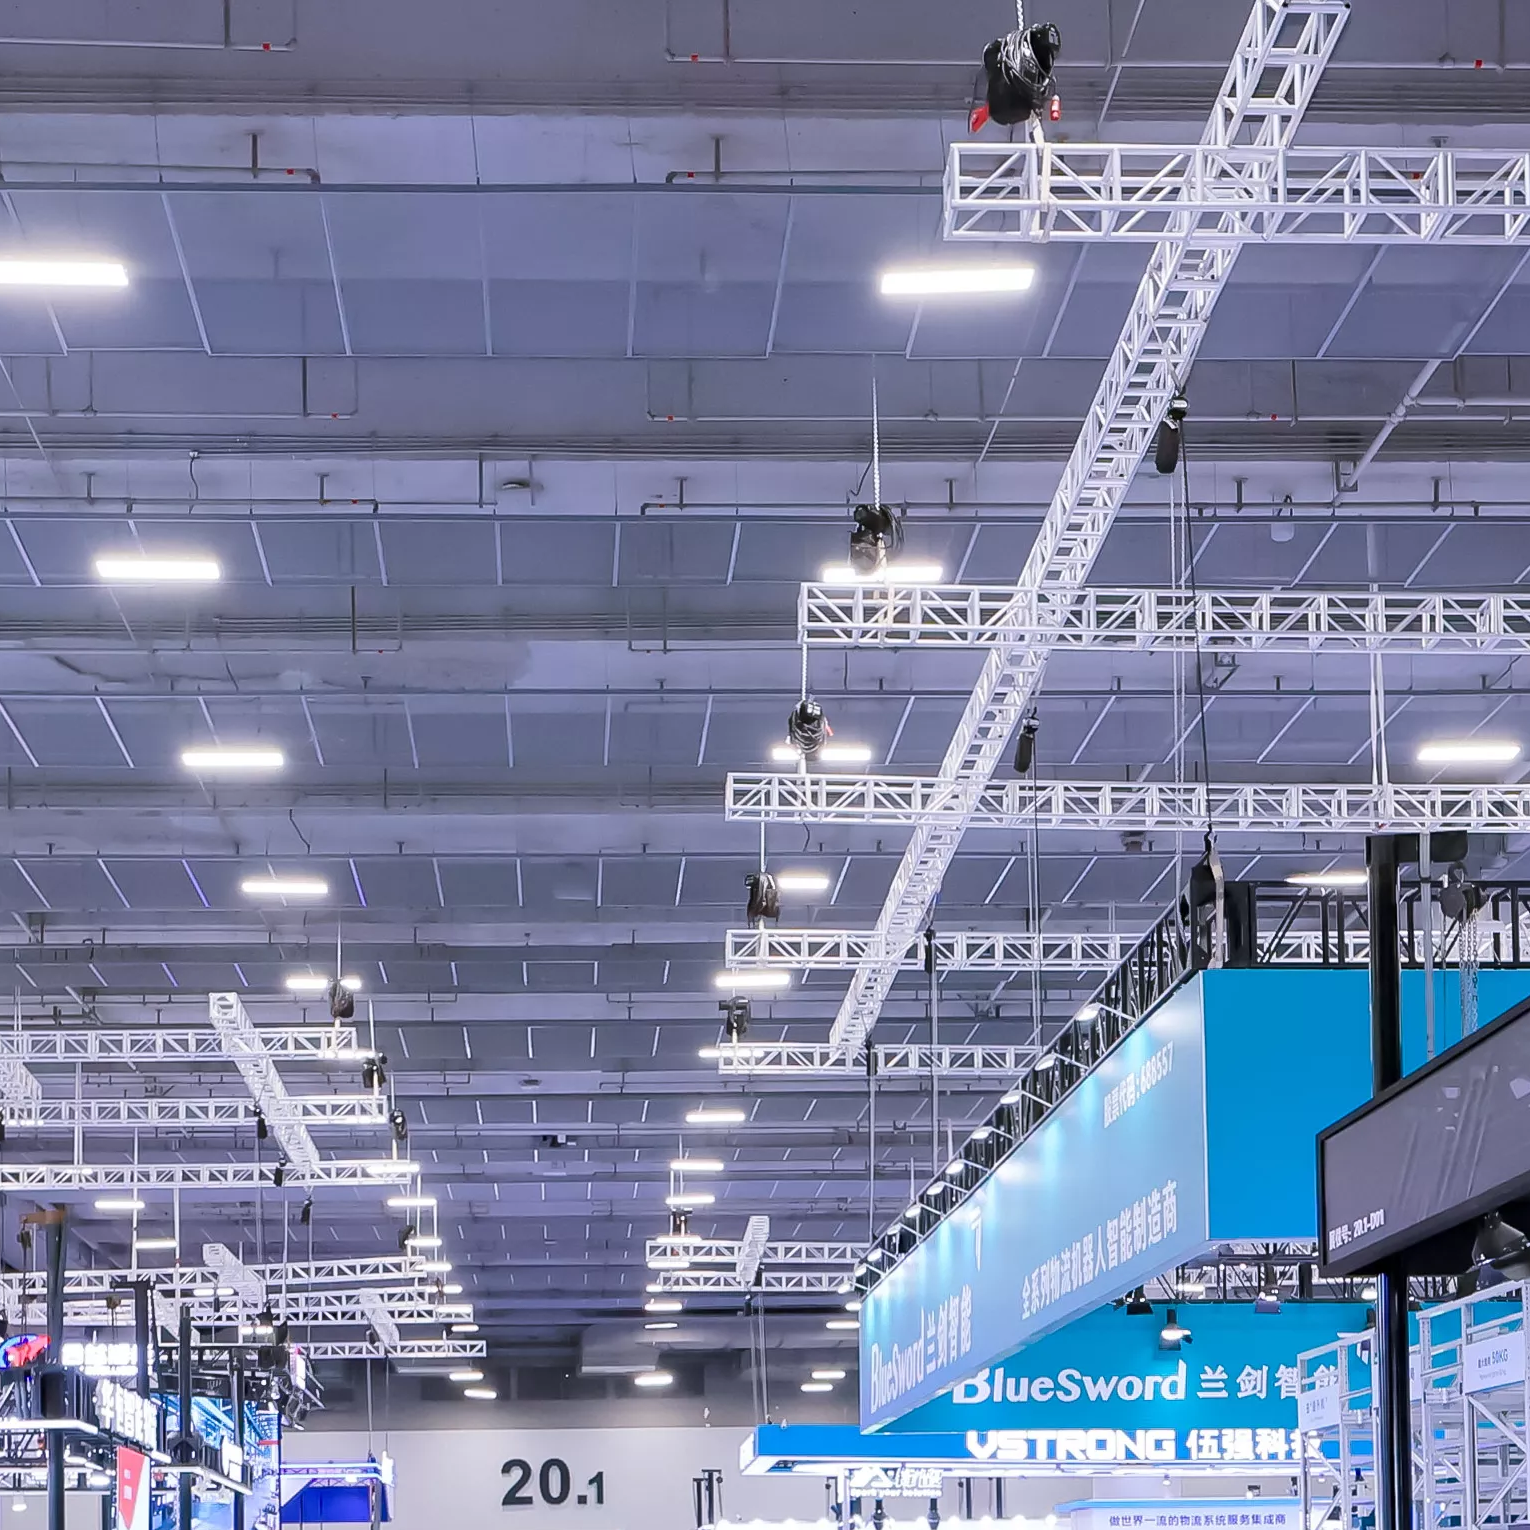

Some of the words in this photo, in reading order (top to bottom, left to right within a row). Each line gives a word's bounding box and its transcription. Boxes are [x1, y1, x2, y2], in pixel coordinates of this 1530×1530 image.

[1021, 1178, 1178, 1321] 全系列物流机器人智能制造商
[870, 1306, 925, 1415] BlueSword
[926, 1283, 972, 1376] 兰剑智能
[952, 1359, 1187, 1404] BlueSword
[965, 1429, 1176, 1460] VSTRONG
[501, 1458, 605, 1506] 20.1
[1109, 1513, 1287, 1527] 做世界一流的物流系统服务集成商
